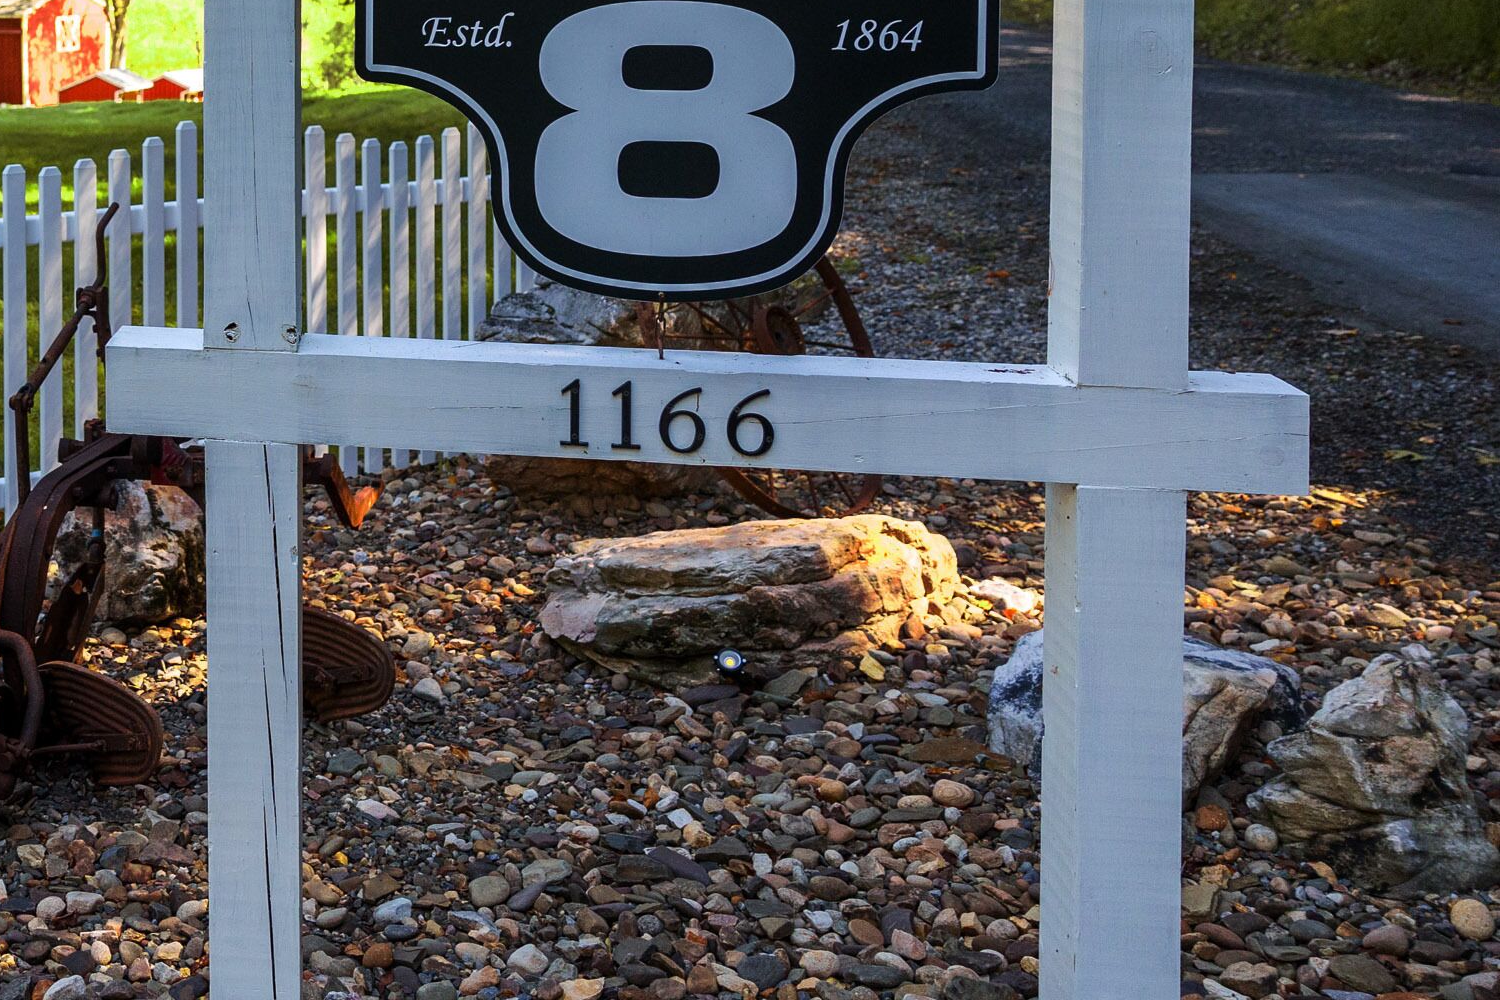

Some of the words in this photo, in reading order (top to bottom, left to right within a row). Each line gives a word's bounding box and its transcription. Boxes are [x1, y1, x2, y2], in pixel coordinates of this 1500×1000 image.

[420, 11, 516, 49] Estd.
[830, 18, 924, 53] 1864
[533, 0, 798, 257] 8
[559, 377, 775, 457] 1166
